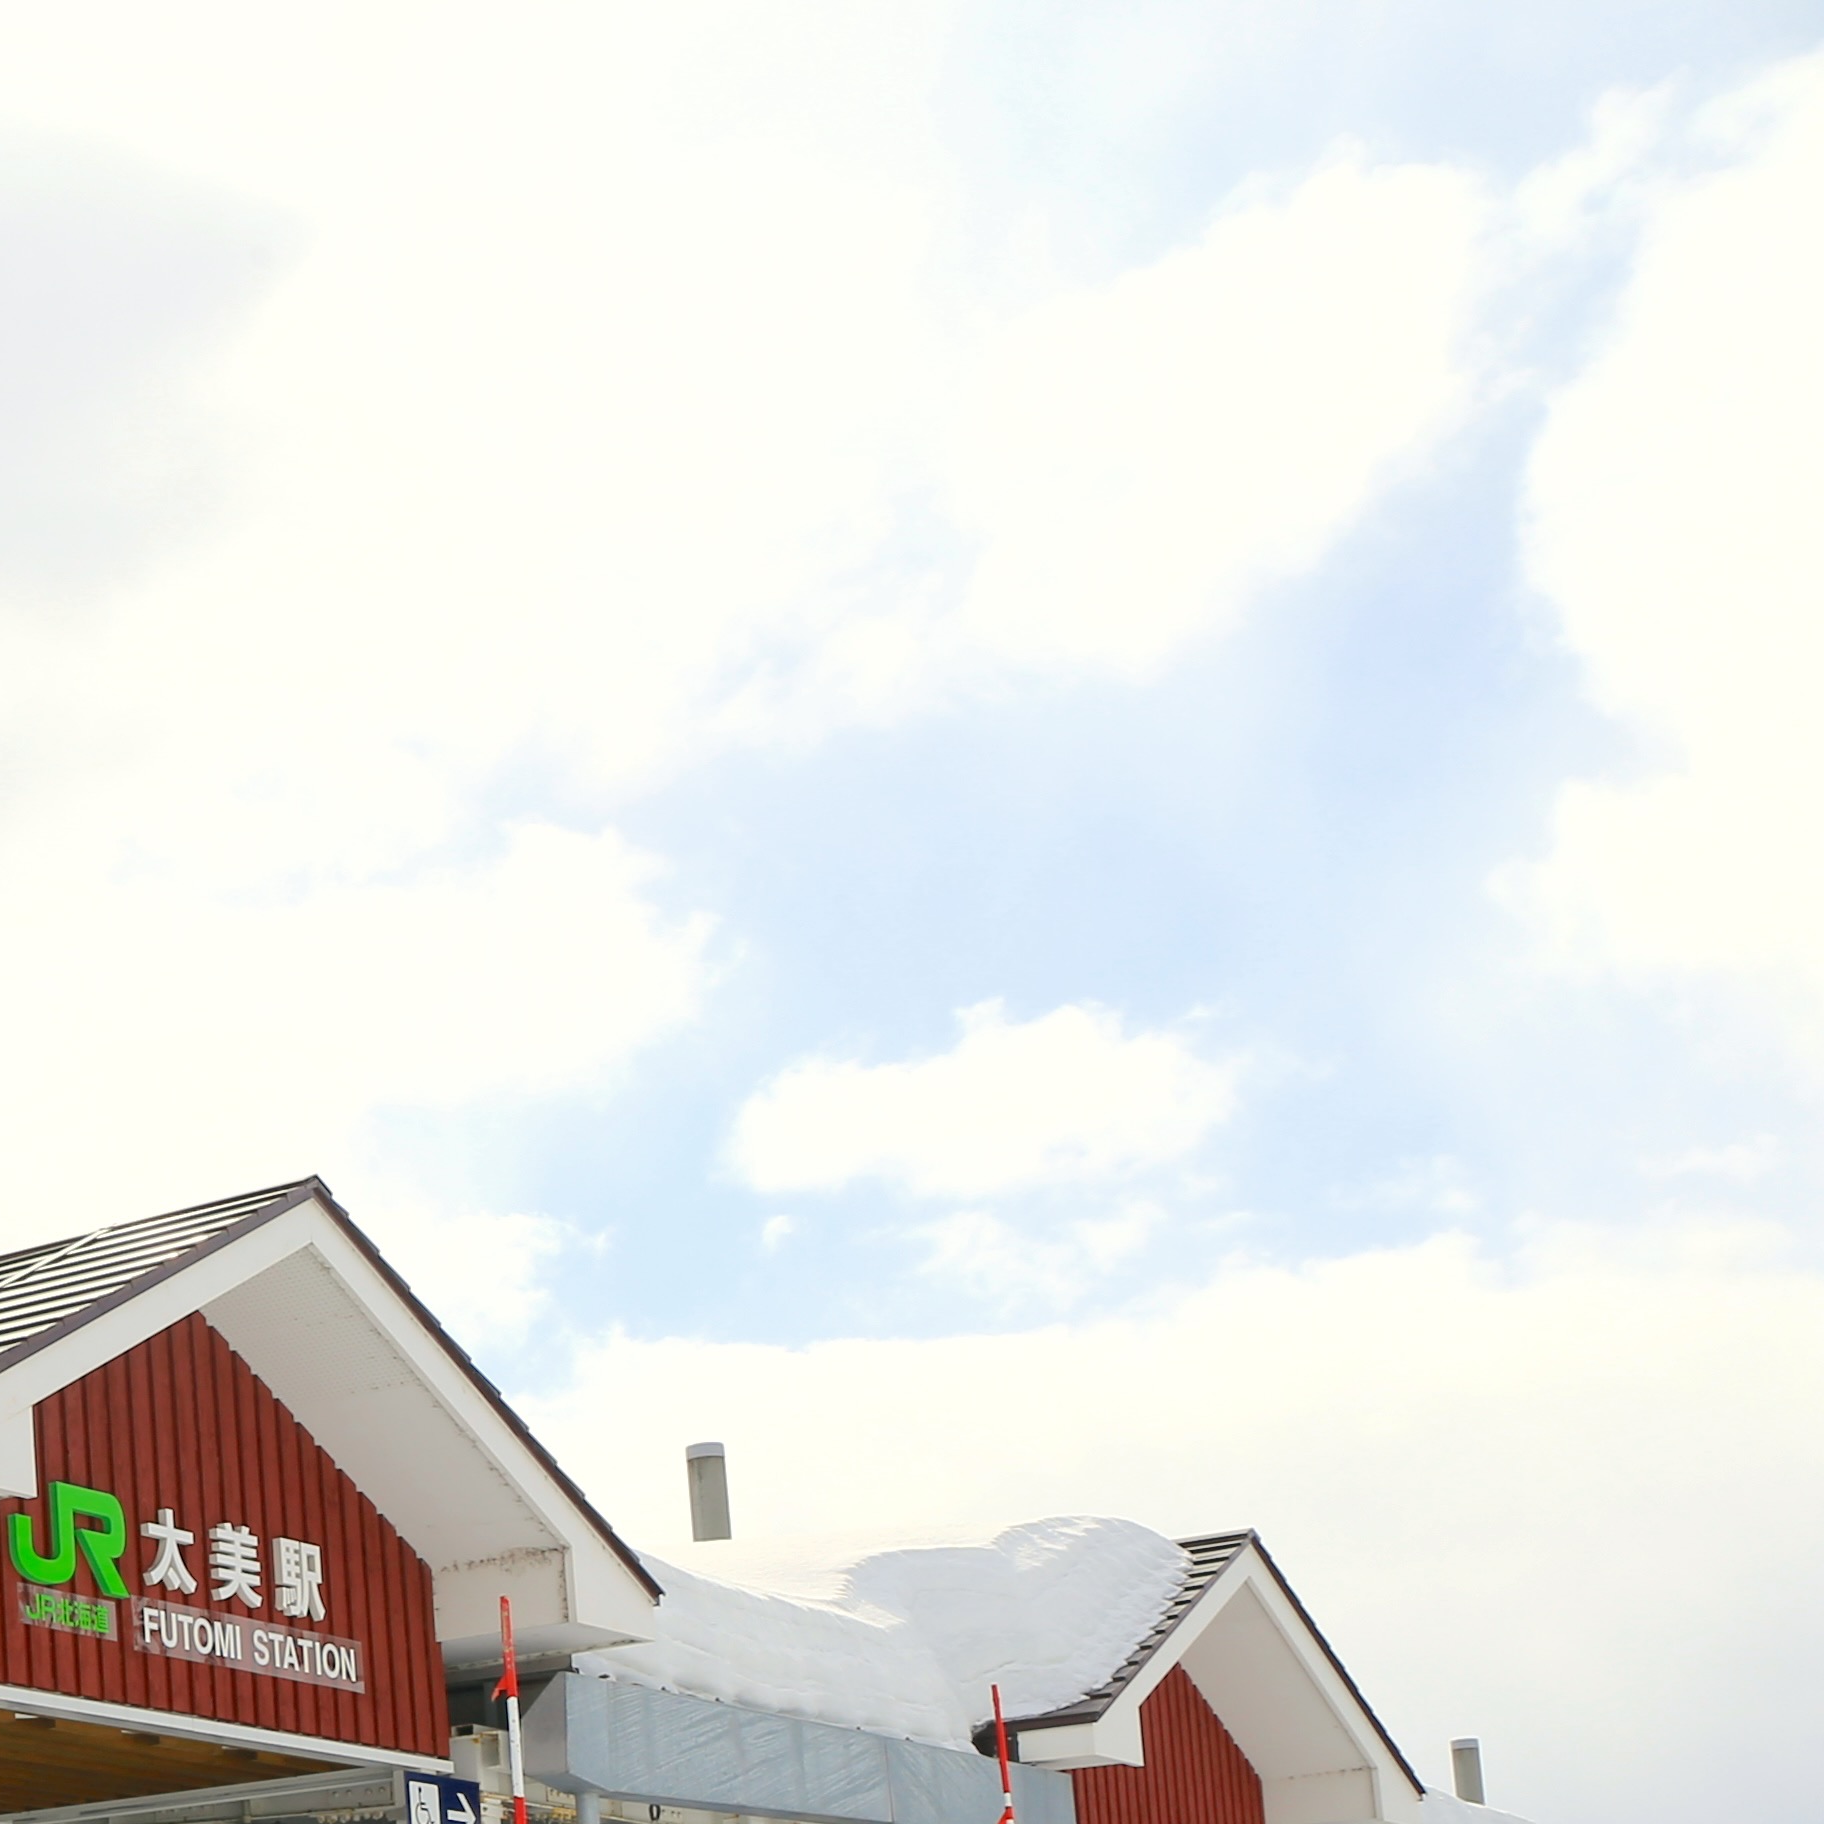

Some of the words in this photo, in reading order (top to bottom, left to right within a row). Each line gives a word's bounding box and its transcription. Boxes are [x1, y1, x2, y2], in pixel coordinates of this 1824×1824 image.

[7, 1481, 131, 1599] JR
[140, 1507, 327, 1623] 太美駅
[25, 1592, 111, 1634] JR北海道
[142, 1606, 243, 1661] FUTOMI
[252, 1628, 358, 1683] STATION
